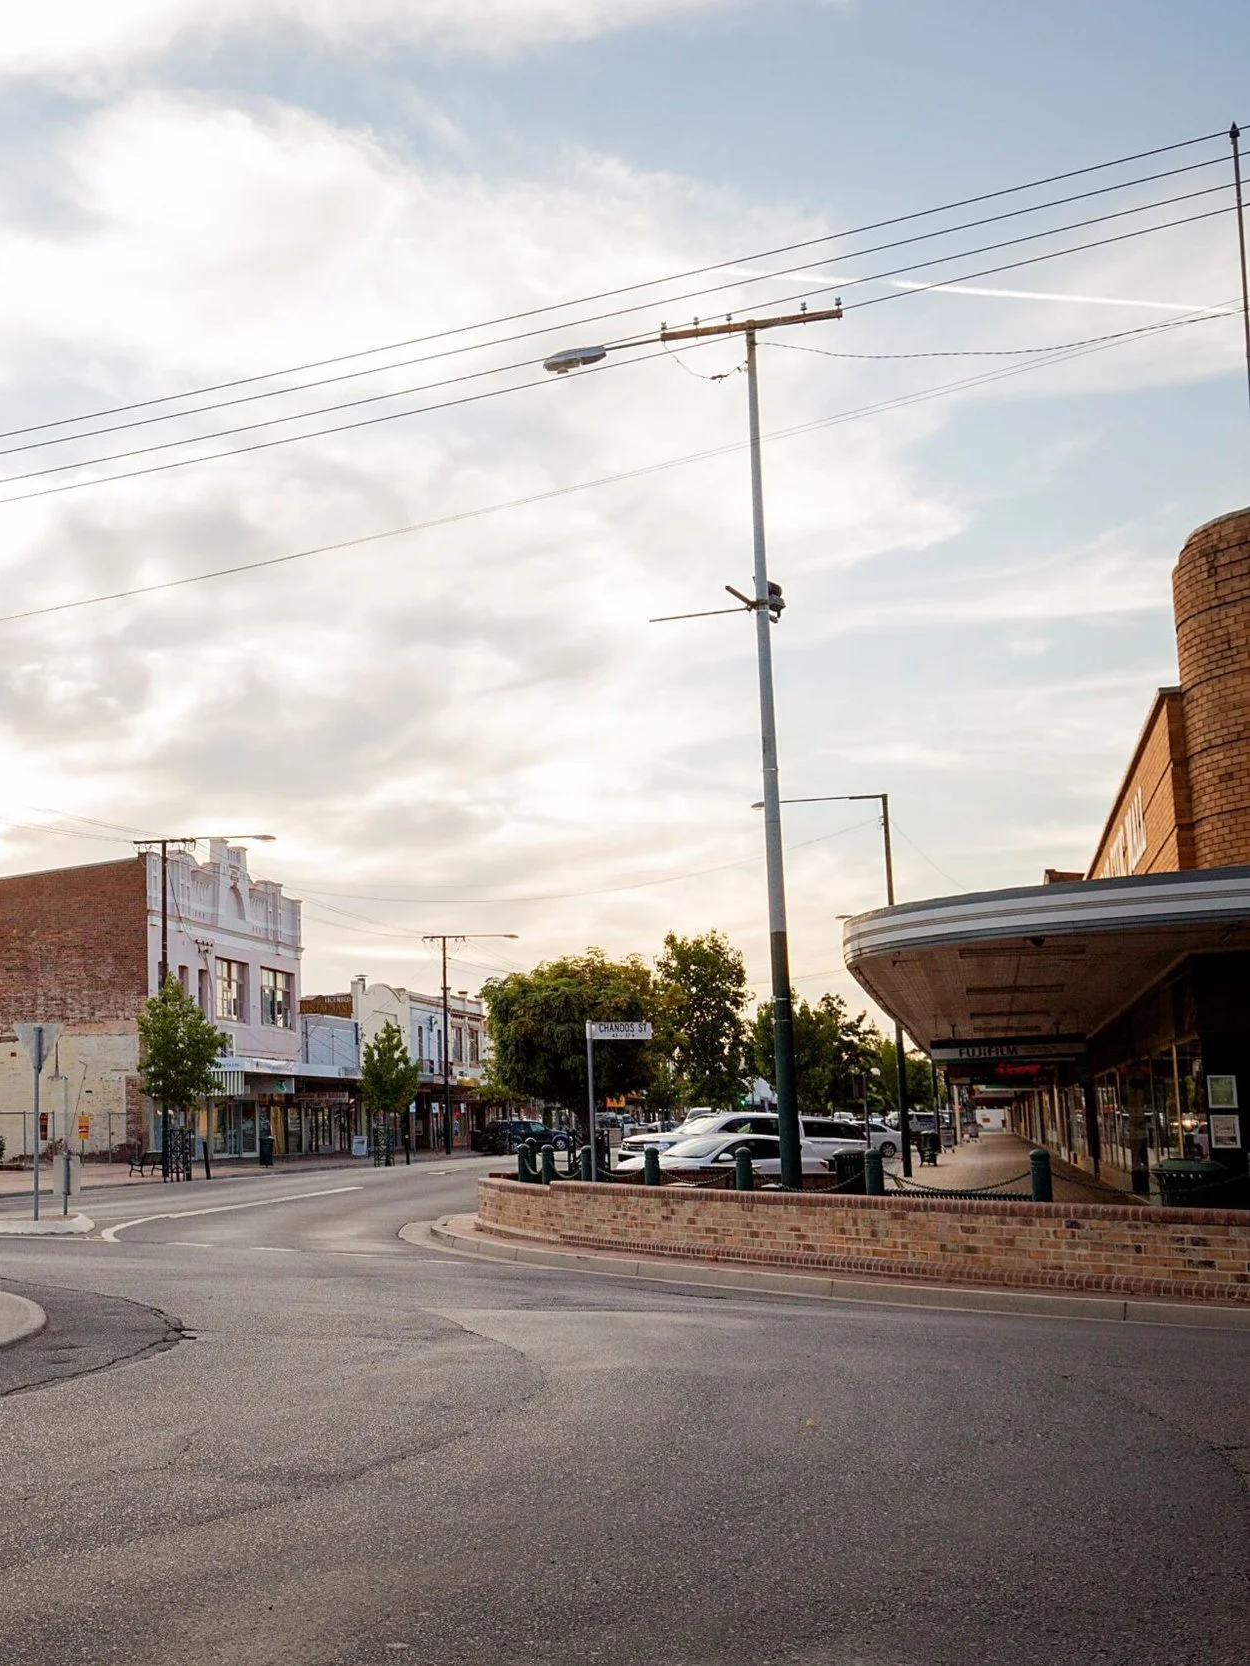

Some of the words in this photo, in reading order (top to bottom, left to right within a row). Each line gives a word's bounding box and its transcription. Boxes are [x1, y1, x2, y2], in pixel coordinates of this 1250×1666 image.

[598, 1023, 635, 1032] CHANDOS
[638, 1023, 647, 1032] ST
[958, 1046, 1019, 1059] FUJIFILM
